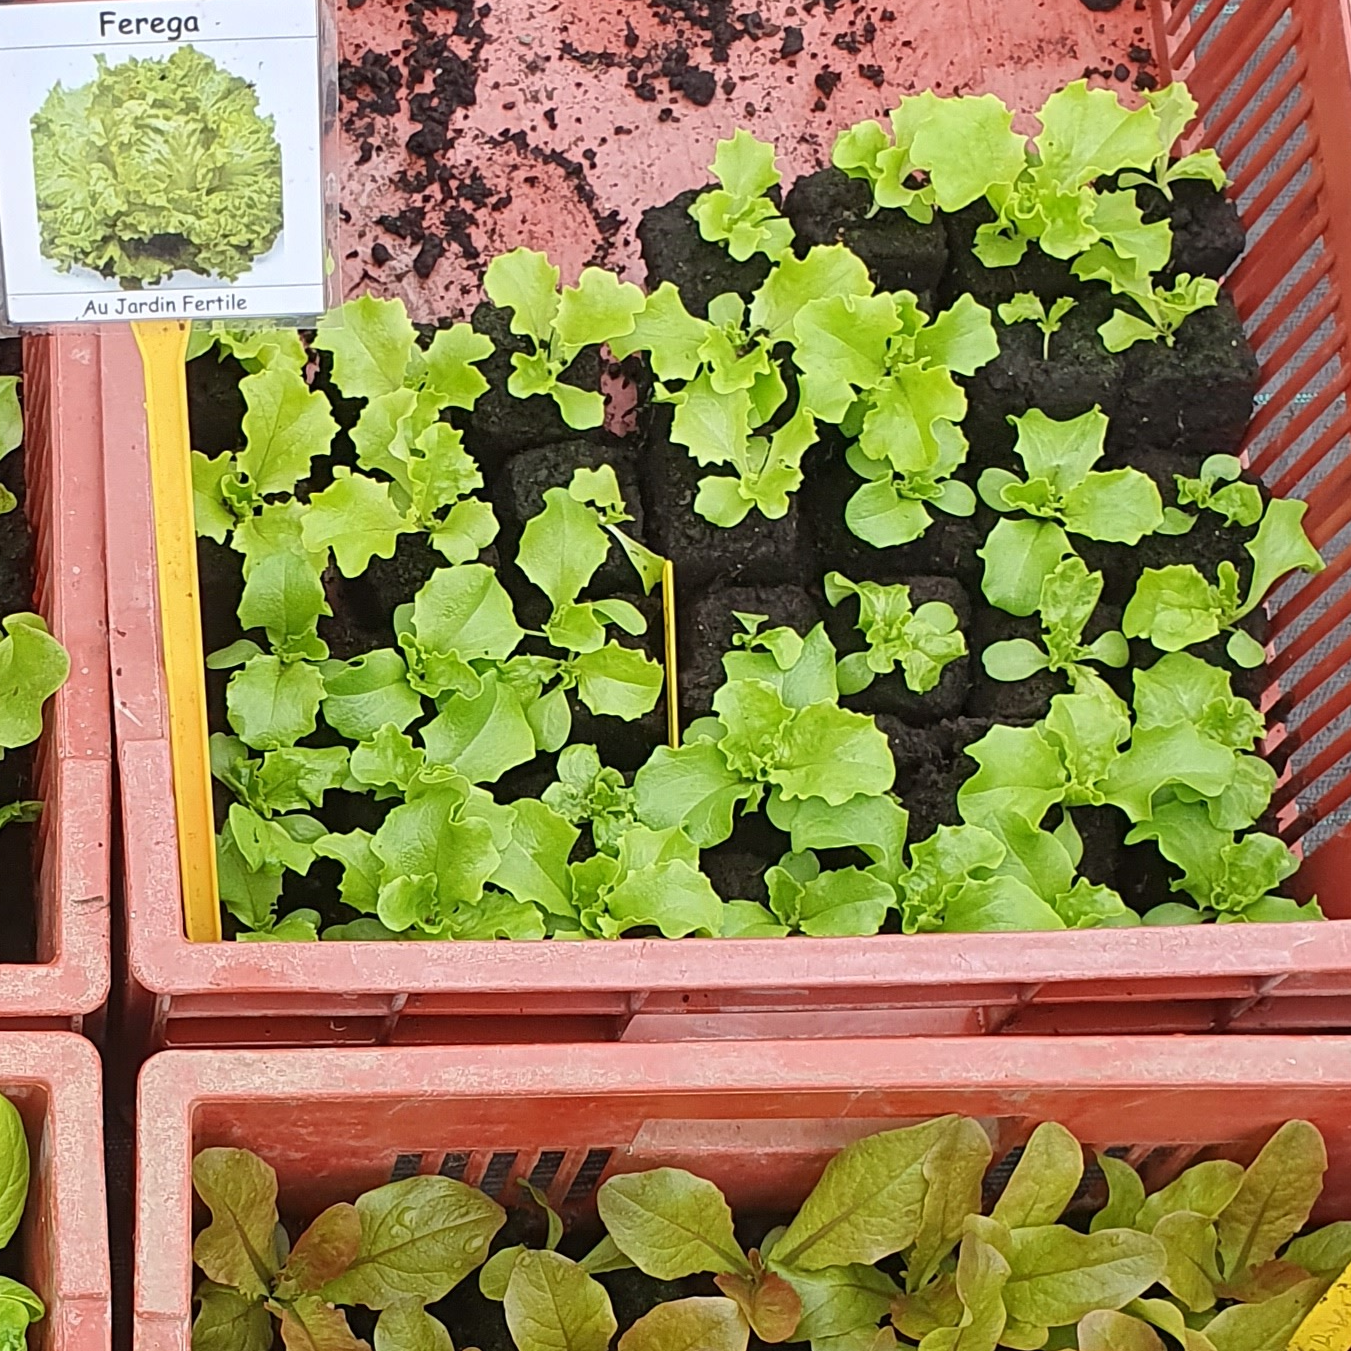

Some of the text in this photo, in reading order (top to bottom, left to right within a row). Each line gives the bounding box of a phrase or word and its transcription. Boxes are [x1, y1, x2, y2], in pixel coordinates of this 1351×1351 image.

[99, 11, 200, 41] Ferega
[83, 294, 248, 316] Au Jardin Fertile
